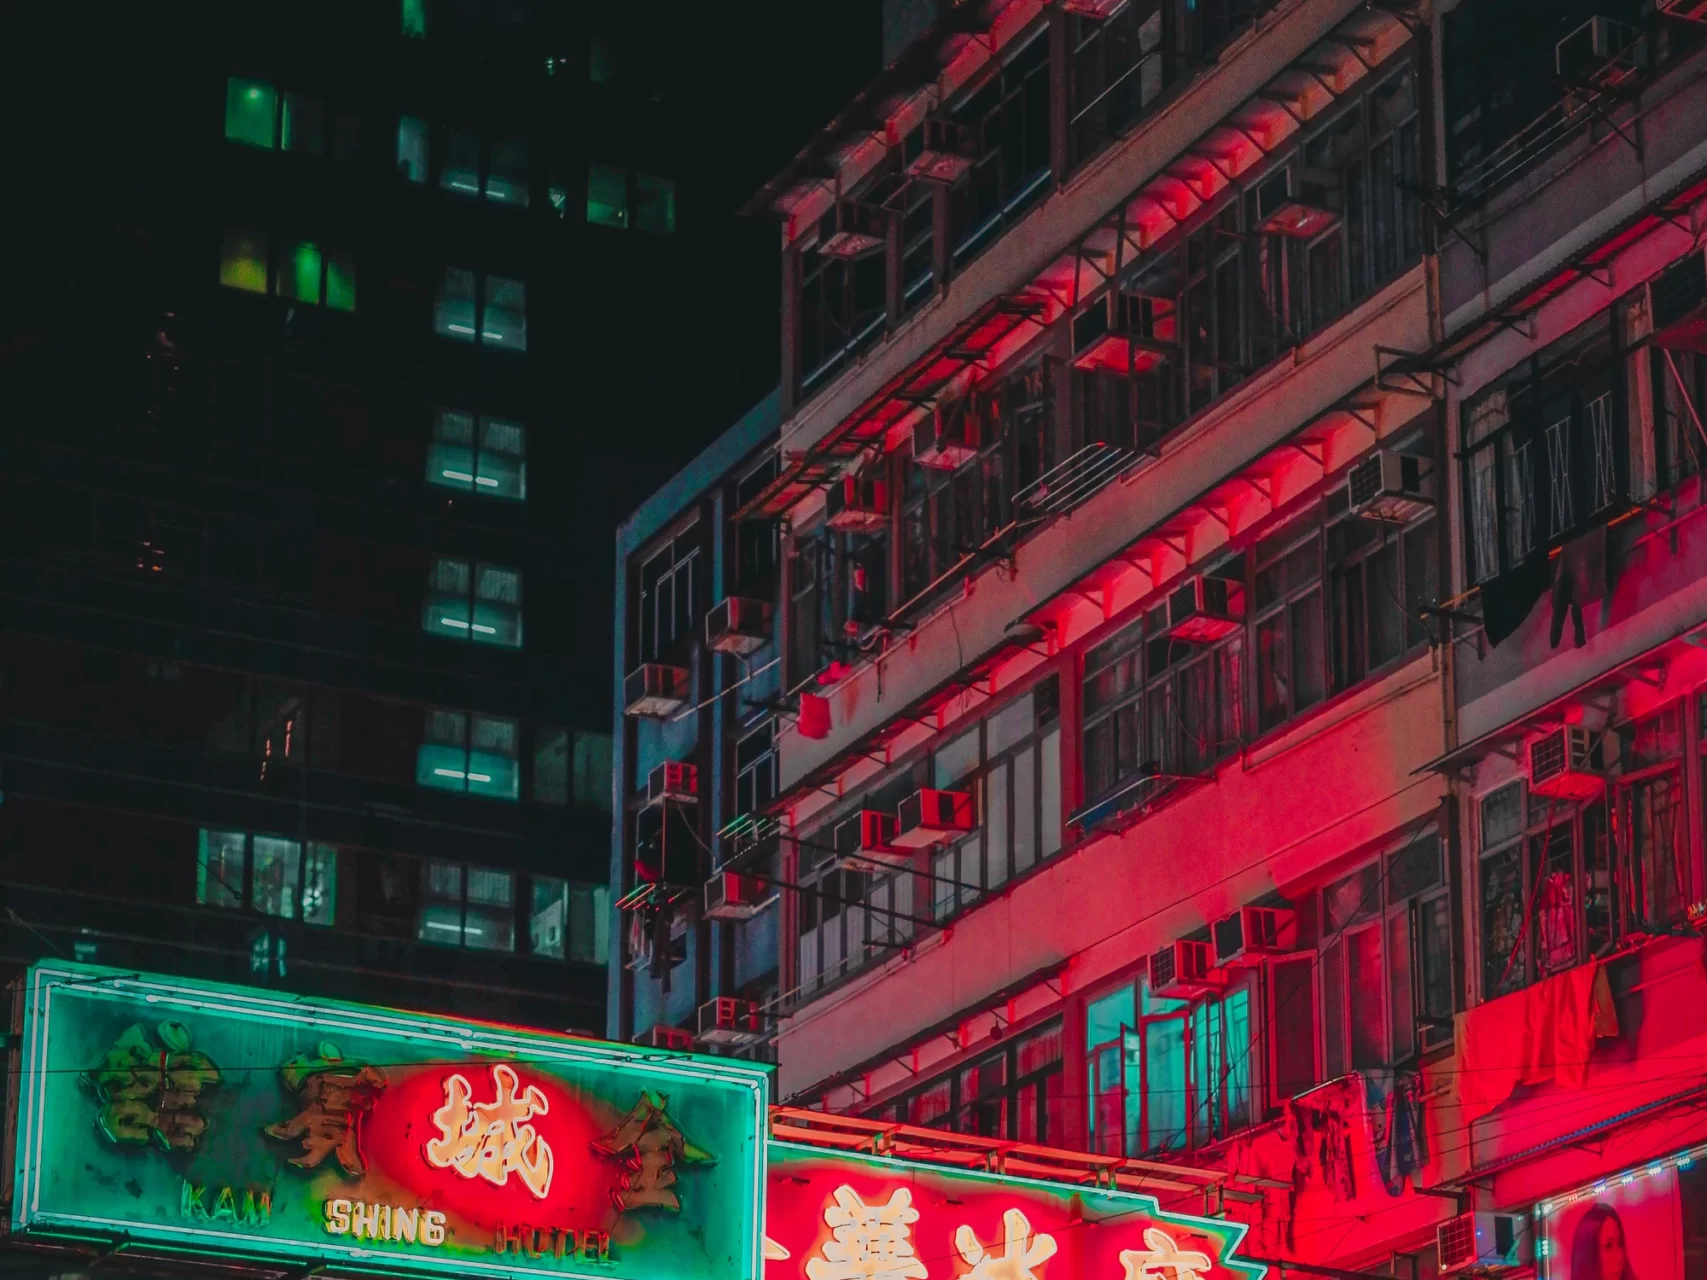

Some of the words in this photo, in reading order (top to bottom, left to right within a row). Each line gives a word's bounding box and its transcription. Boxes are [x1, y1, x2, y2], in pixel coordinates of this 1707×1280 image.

[181, 1180, 272, 1227] KAM
[325, 1198, 446, 1248] SHING
[495, 1221, 617, 1265] HOTEL
